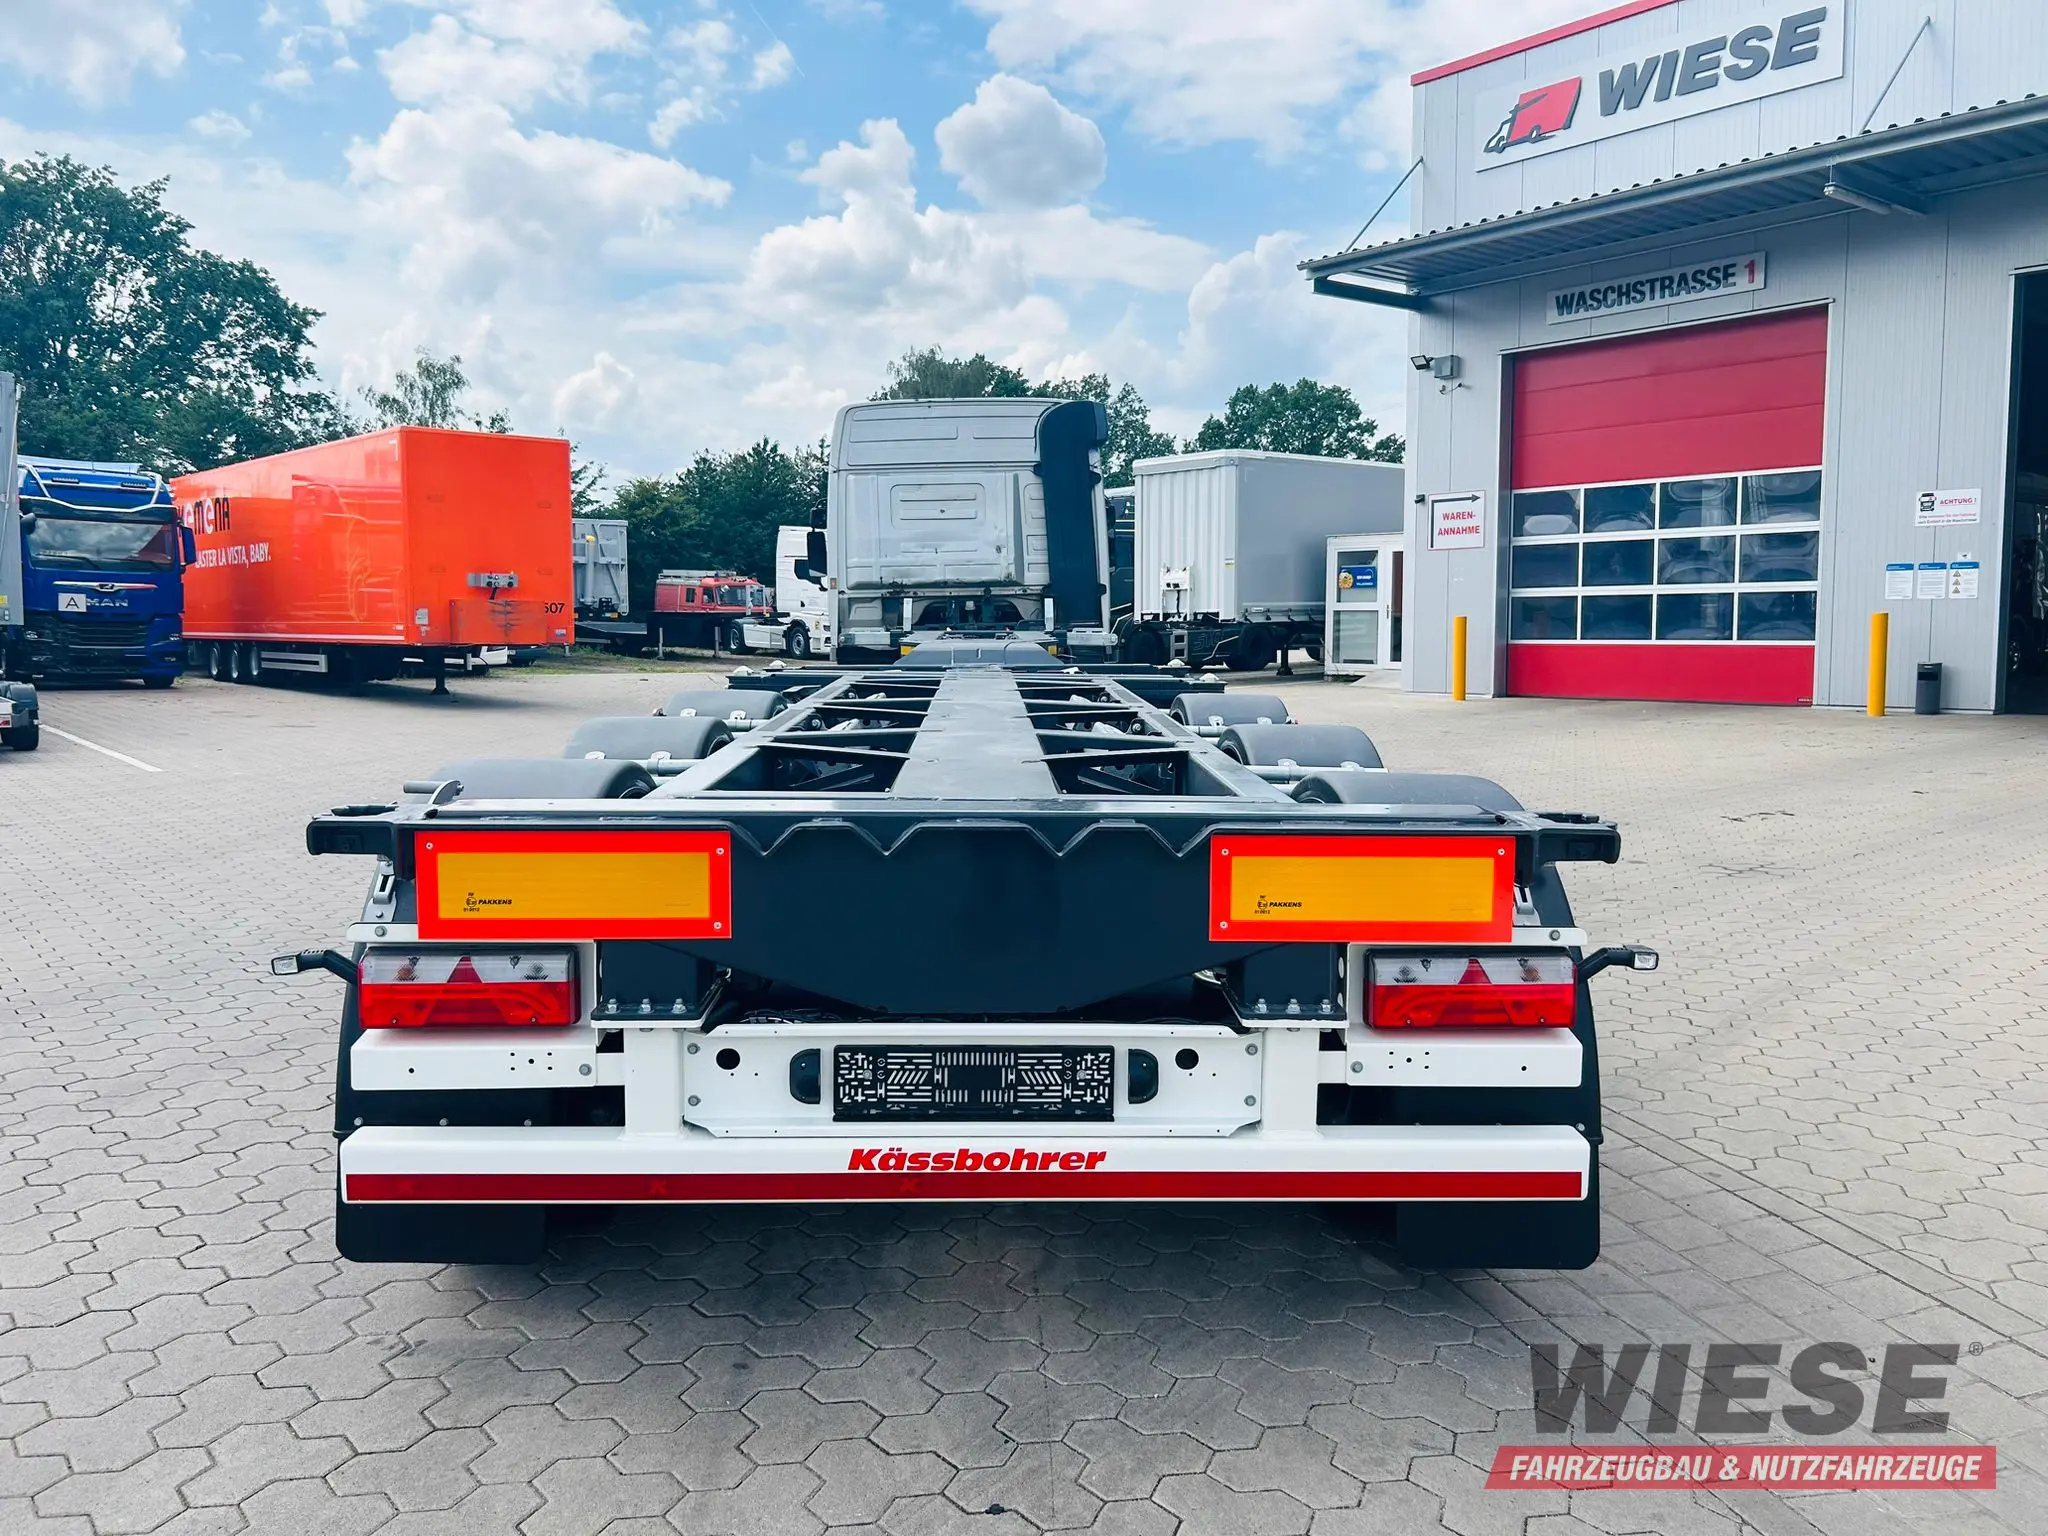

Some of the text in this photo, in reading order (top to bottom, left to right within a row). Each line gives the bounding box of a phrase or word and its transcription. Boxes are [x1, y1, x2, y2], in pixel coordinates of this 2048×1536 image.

[1598, 6, 1827, 117] WIESE
[1555, 259, 1756, 317] WASCHSTRASSE 1
[1442, 511, 1476, 521] WAREN-
[1438, 525, 1480, 537] ANNAHME
[65, 597, 79, 609] A
[86, 598, 128, 607] MAN
[847, 1147, 1106, 1171] Kässbohrer
